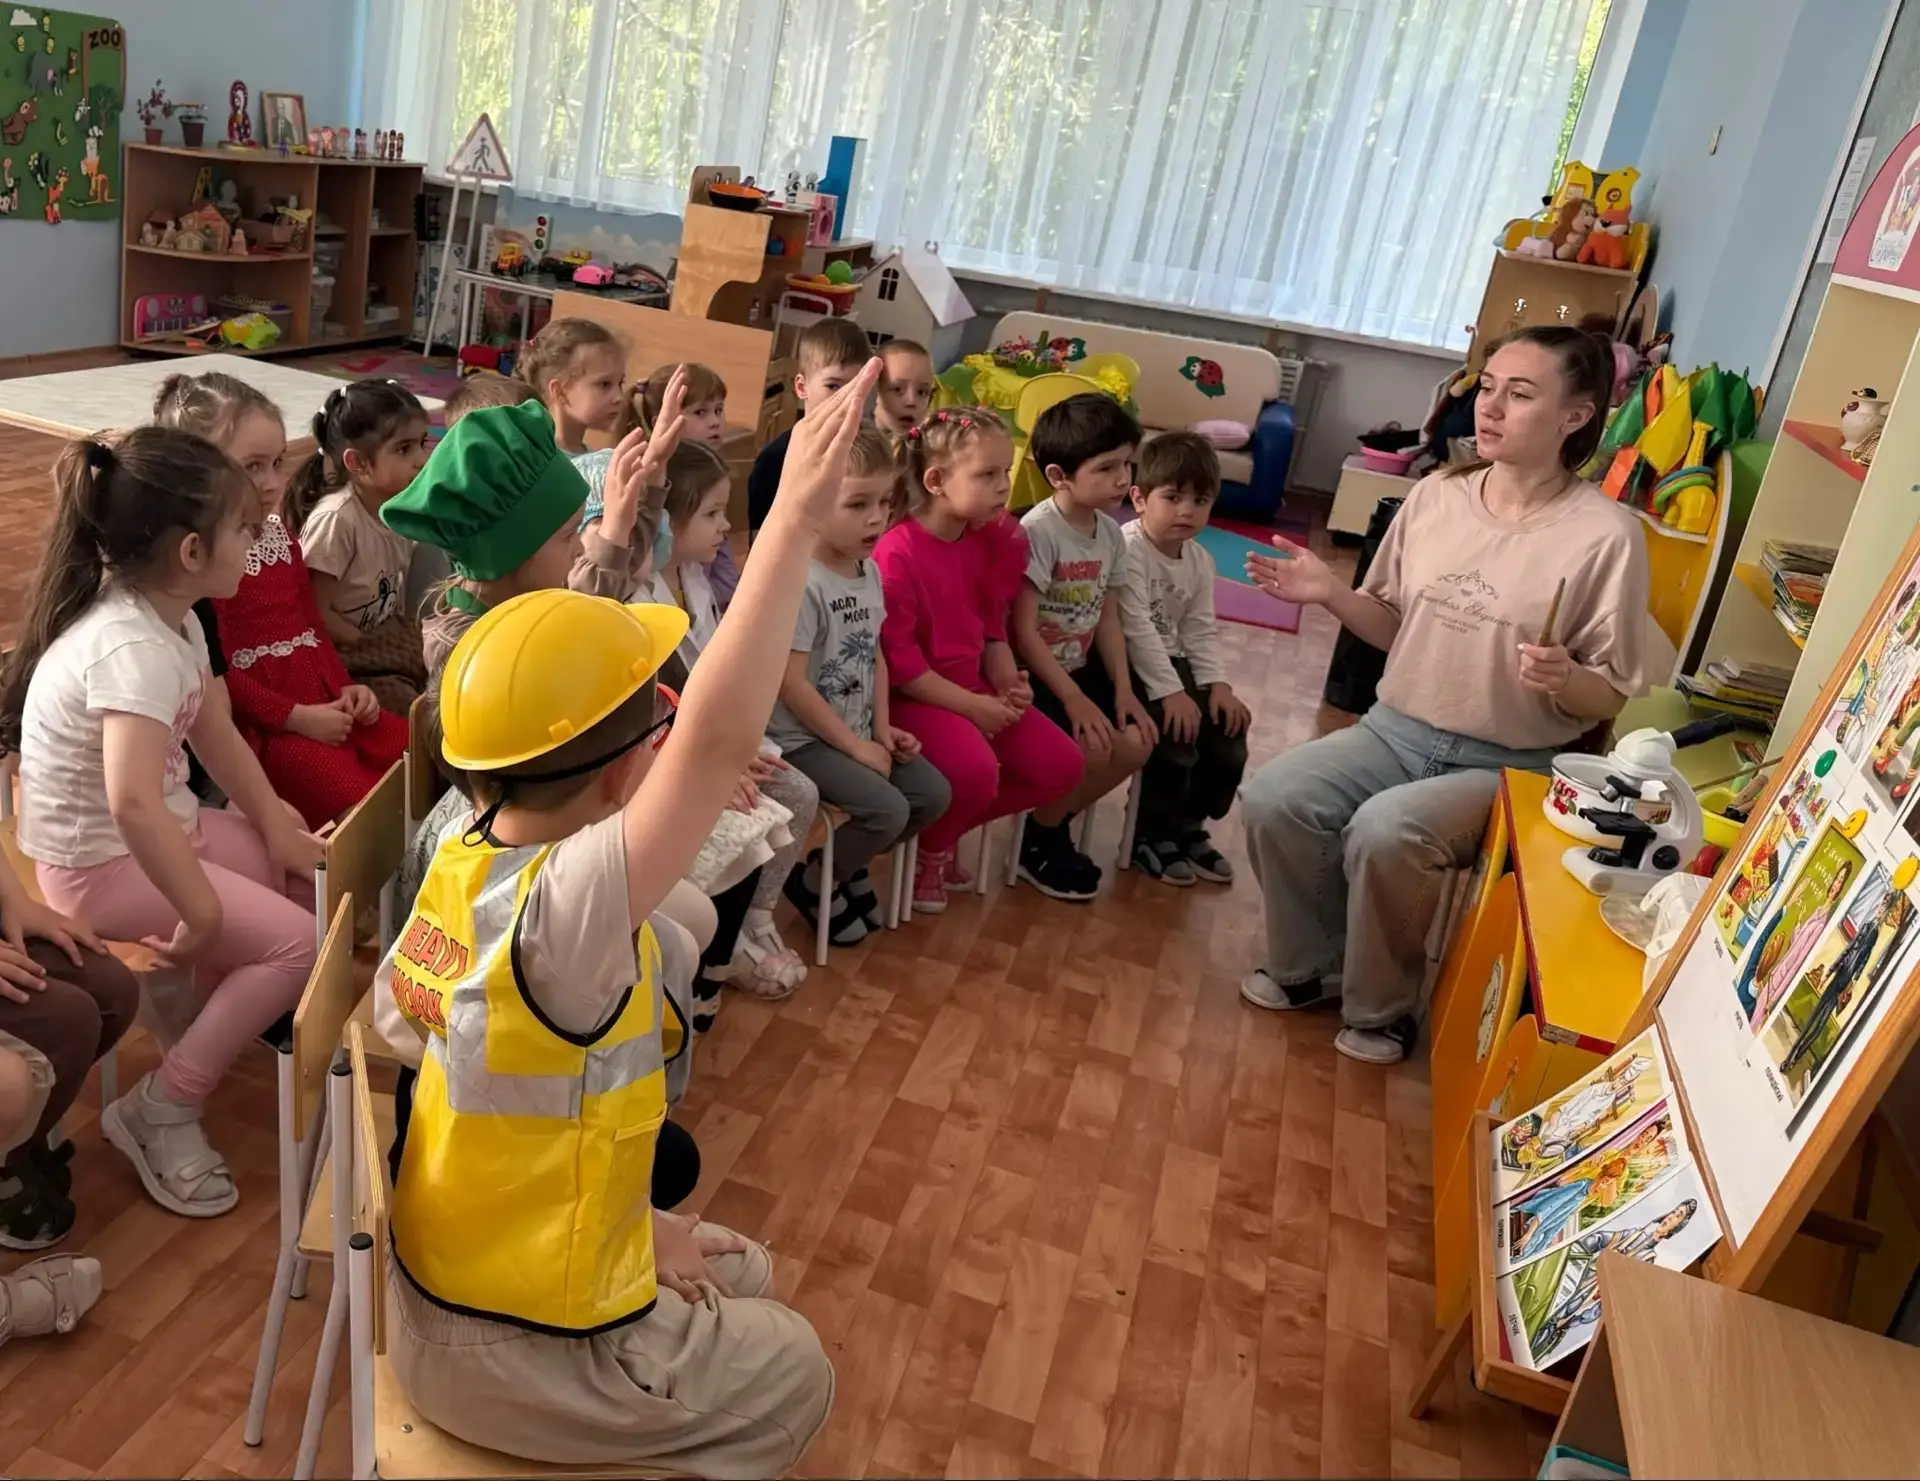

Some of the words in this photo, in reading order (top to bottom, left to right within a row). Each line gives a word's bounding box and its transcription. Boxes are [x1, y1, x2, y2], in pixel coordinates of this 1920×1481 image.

[88, 28, 121, 49] ZOO
[397, 915, 469, 981] HEAVY
[390, 964, 447, 1029] WORK
